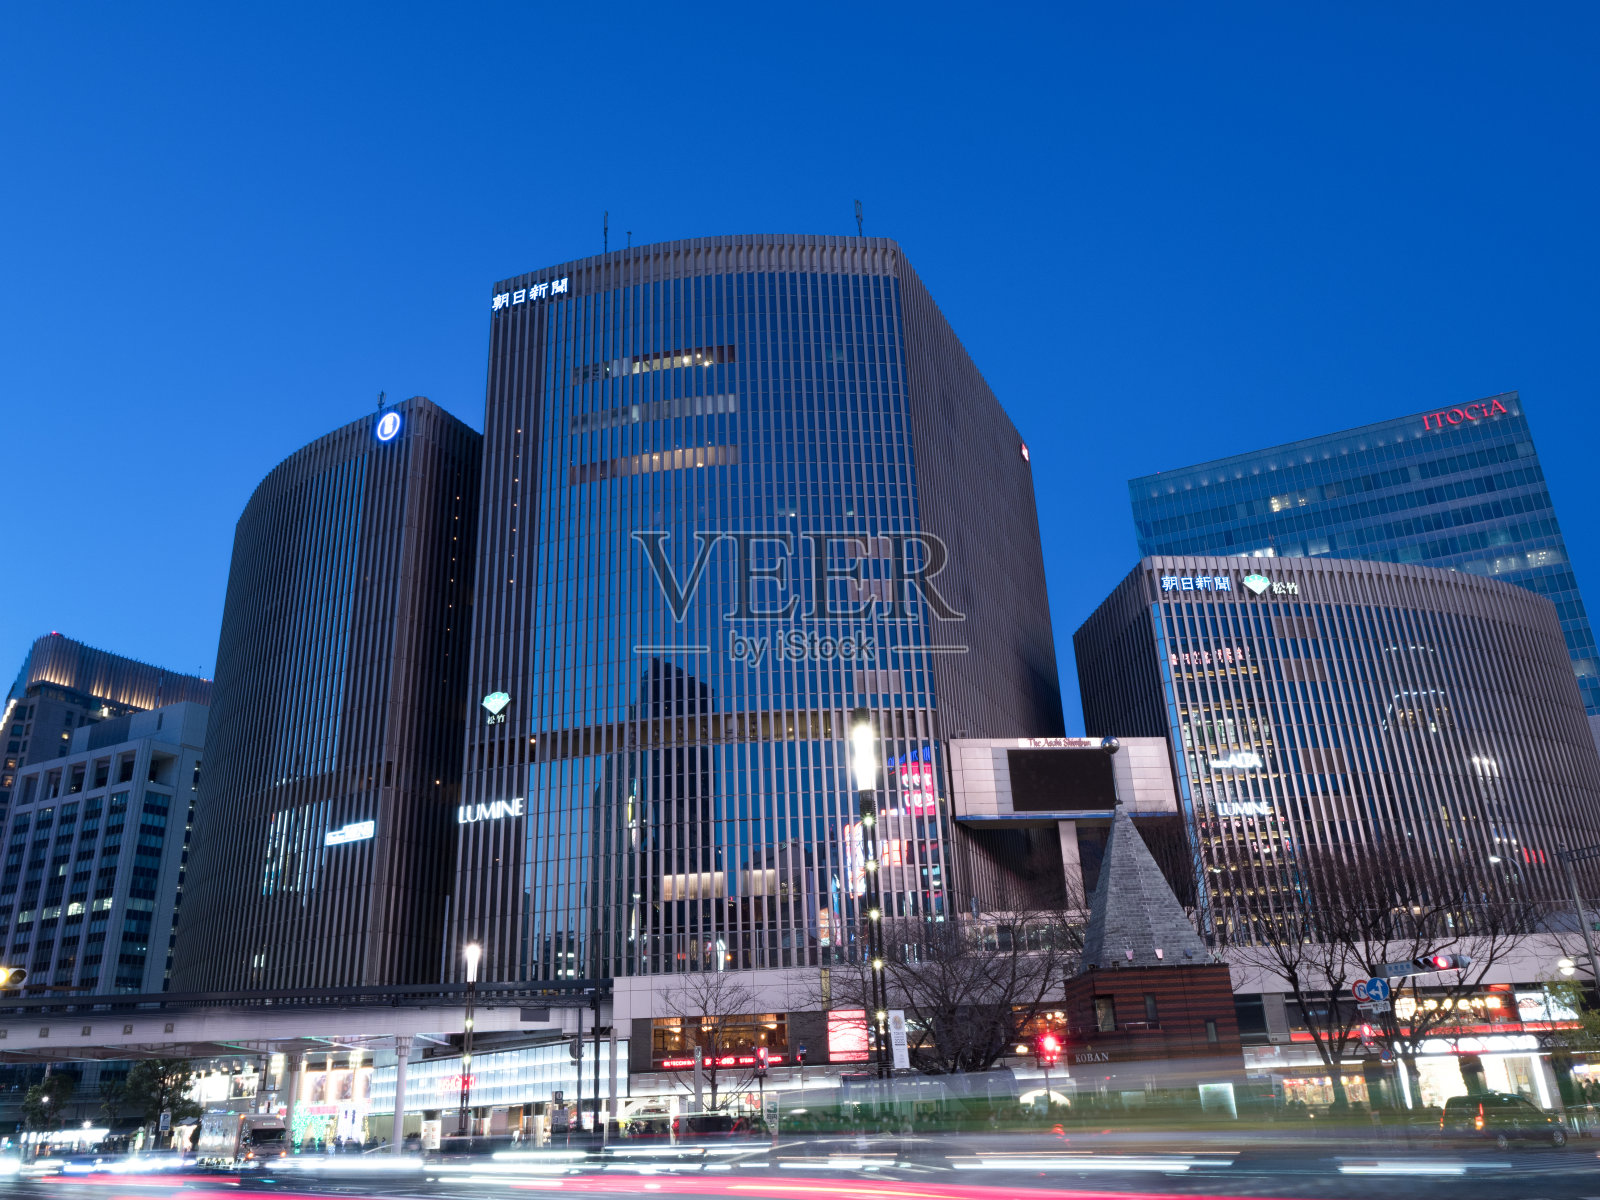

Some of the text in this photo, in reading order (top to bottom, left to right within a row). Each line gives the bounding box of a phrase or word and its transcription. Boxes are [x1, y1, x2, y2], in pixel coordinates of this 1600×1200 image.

[492, 278, 568, 311] 朝日新聞
[1161, 575, 1231, 592] 朝日新聞
[1272, 582, 1299, 595] 松竹
[487, 713, 506, 725] 松竹
[1027, 738, 1041, 747] The
[1042, 738, 1062, 747] Asahi
[458, 798, 524, 823] LUMINE
[1217, 802, 1271, 816] LUMINE
[1075, 1052, 1109, 1063] KOBAN
